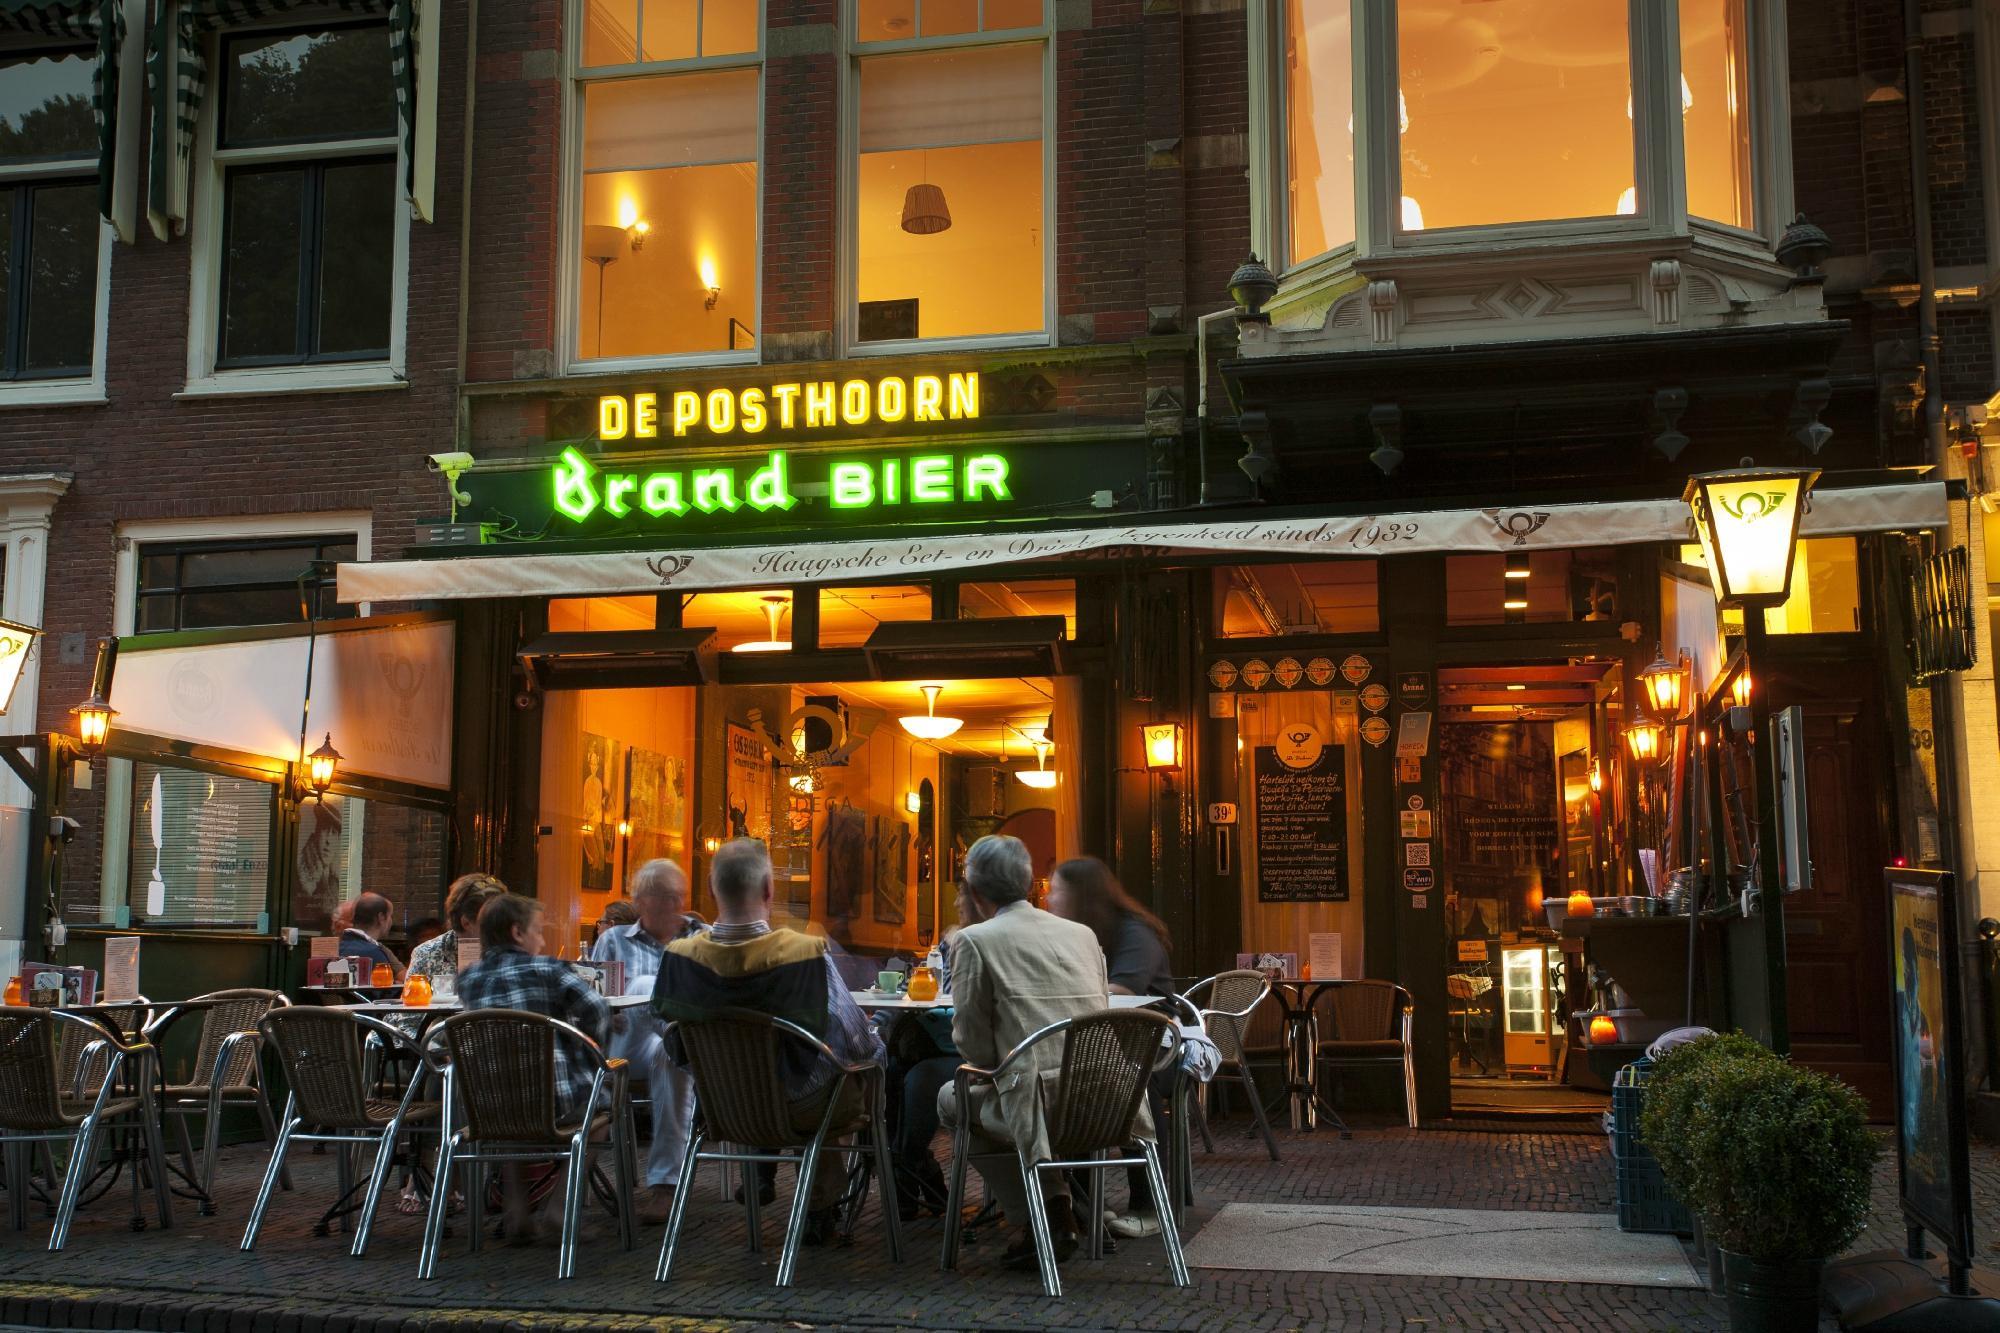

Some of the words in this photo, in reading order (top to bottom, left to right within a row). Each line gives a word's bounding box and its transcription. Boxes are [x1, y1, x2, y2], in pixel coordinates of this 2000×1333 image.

[598, 392, 658, 442] DE
[672, 370, 981, 438] POSTHOORN
[551, 444, 800, 524] Brand
[828, 453, 1016, 510] BIER
[752, 547, 888, 578] Haagsche
[899, 544, 953, 566] Eet-
[965, 548, 994, 562] en
[1262, 523, 1337, 544] sinds
[1347, 523, 1420, 549] 1932
[734, 734, 765, 761] OSBORN
